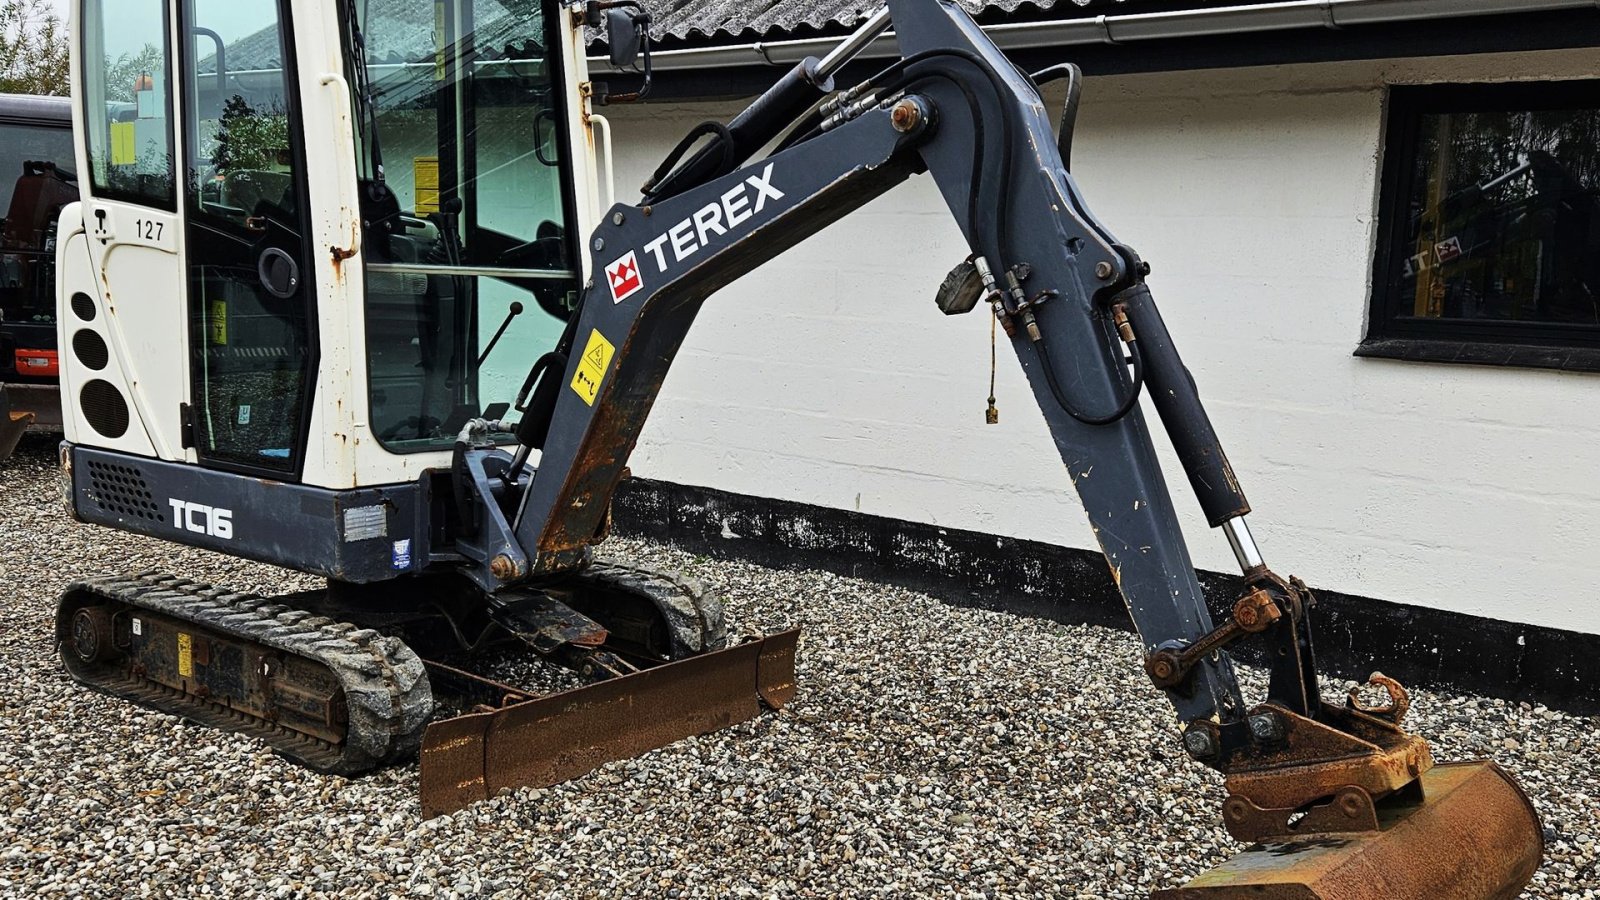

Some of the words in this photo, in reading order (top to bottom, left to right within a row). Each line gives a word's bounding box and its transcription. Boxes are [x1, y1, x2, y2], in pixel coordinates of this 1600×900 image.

[136, 218, 164, 241] 127
[643, 162, 785, 272] TEREX
[168, 497, 233, 540] TC16
